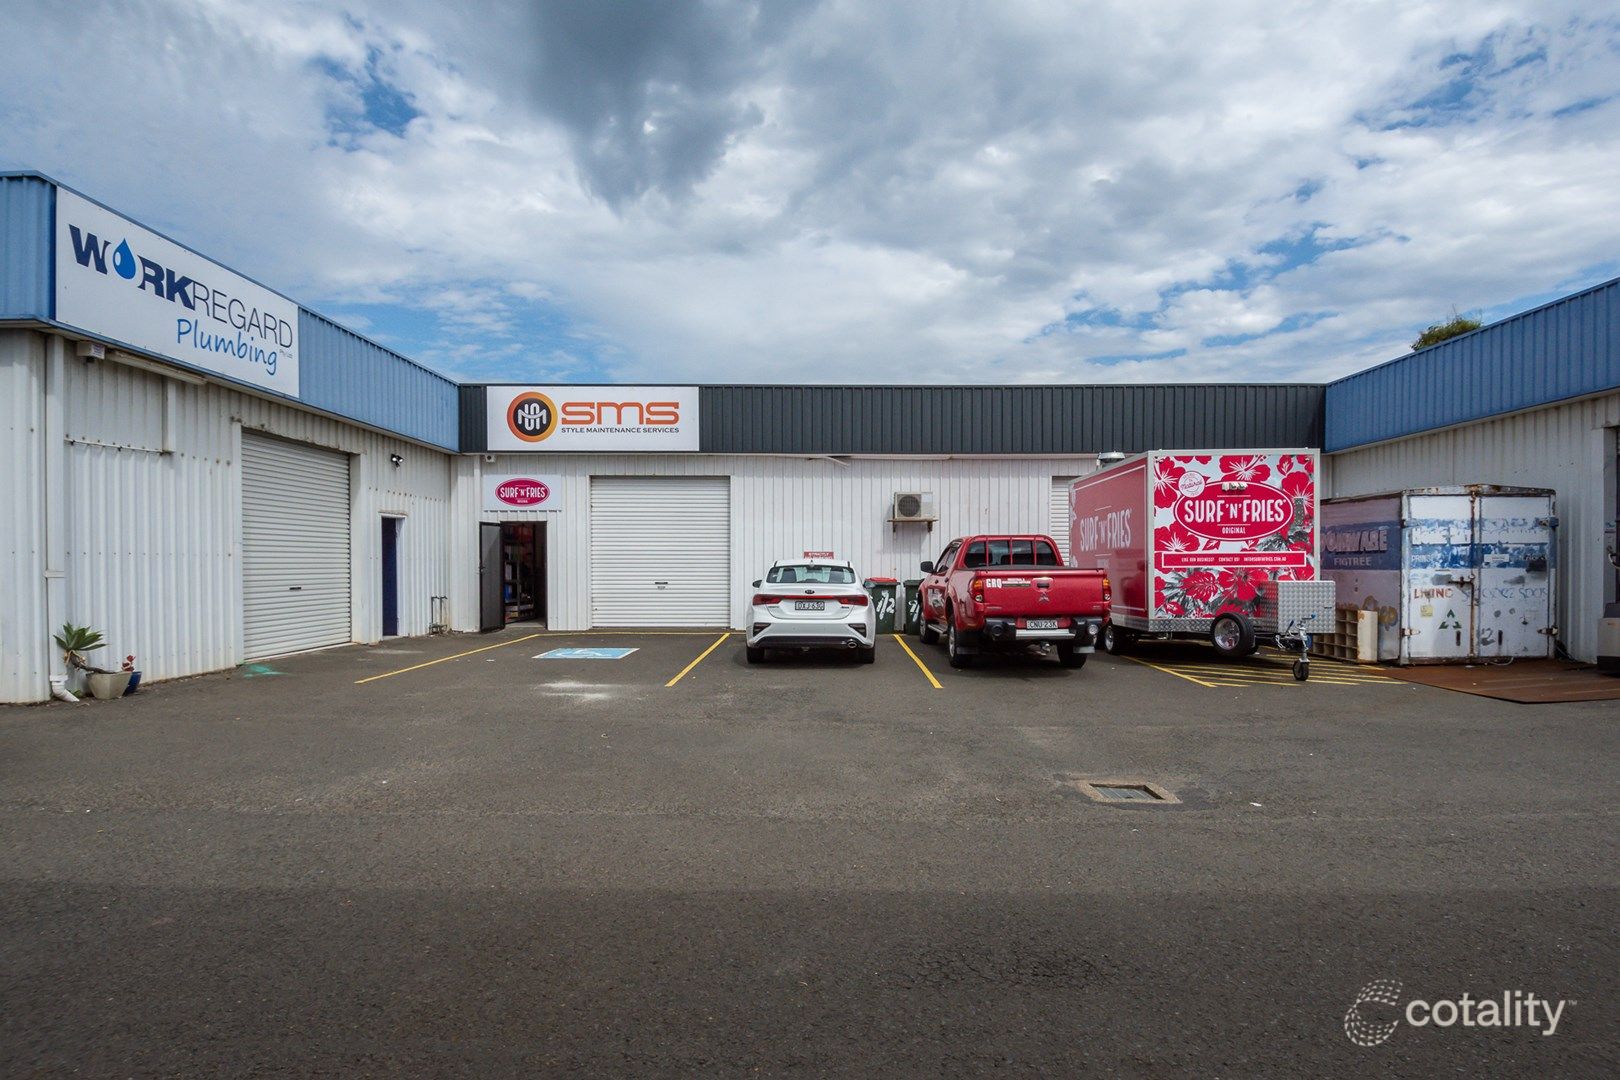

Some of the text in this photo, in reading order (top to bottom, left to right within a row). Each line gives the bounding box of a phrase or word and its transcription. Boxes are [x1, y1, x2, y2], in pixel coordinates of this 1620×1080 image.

[176, 318, 278, 376] Plumbing
[500, 486, 519, 498] SURF
[526, 486, 546, 498] FRIES
[1184, 499, 1225, 523] SURF
[1242, 499, 1286, 522] FRIES
[1080, 515, 1099, 552] SURF
[1107, 508, 1132, 549] FRIES
[1221, 526, 1246, 535] ORIGINAL
[1333, 556, 1372, 566] FIGTREE
